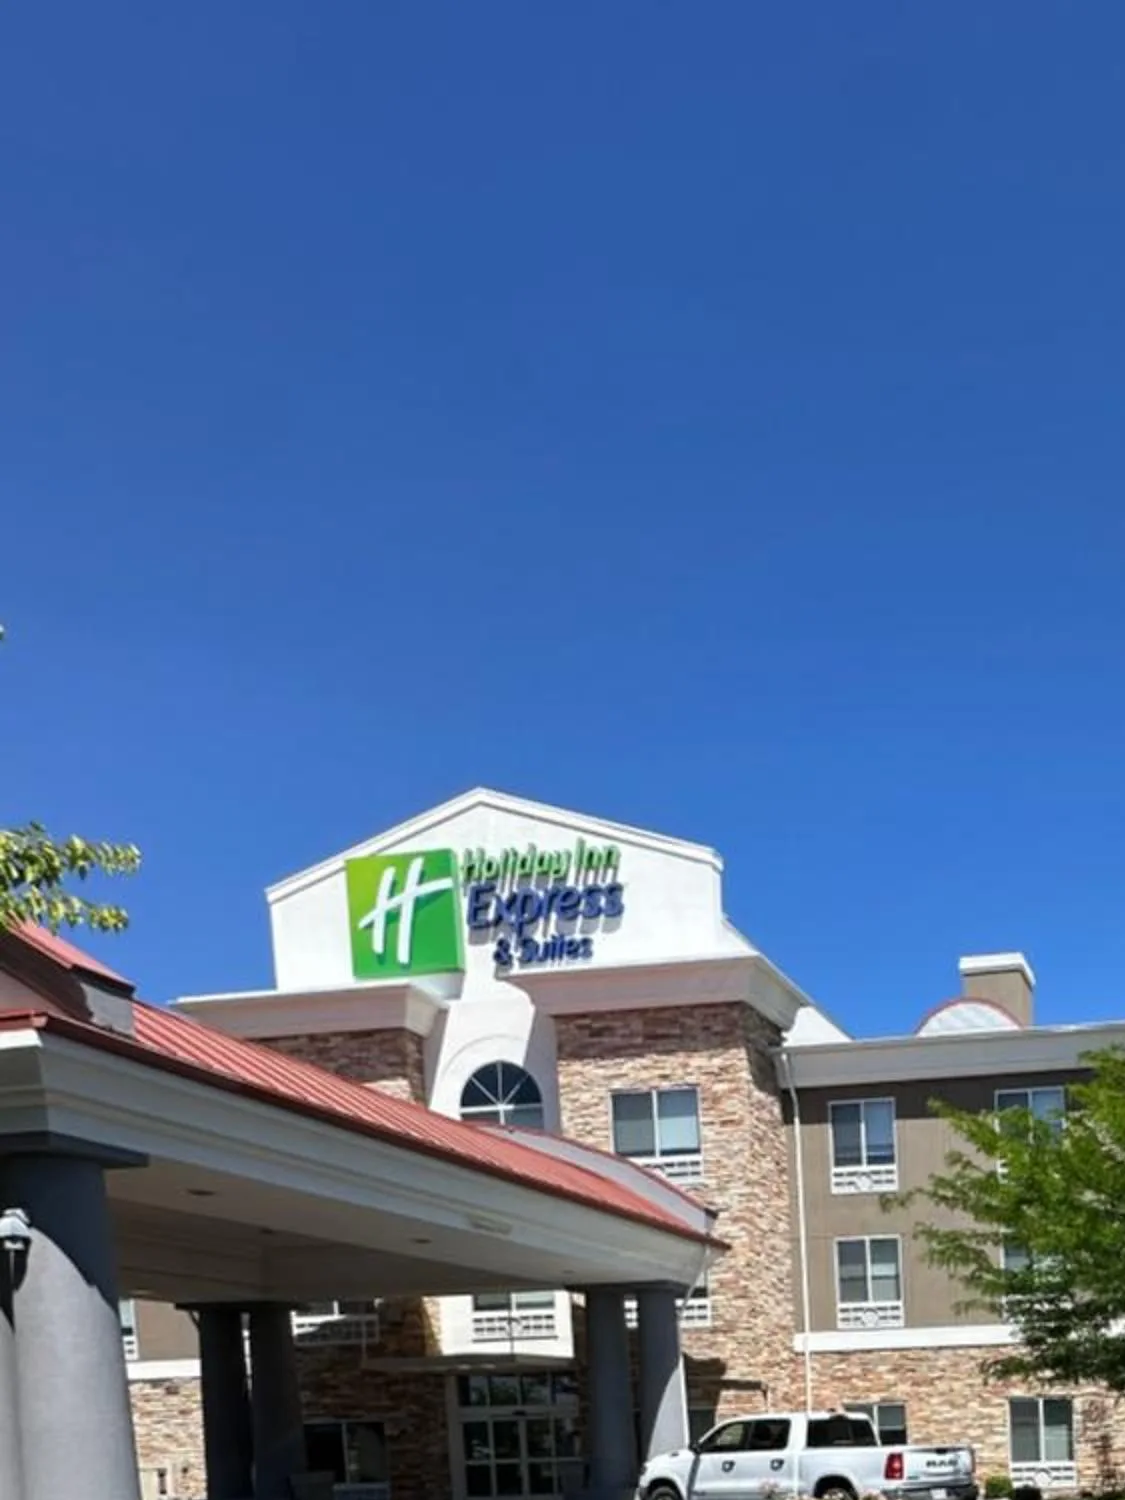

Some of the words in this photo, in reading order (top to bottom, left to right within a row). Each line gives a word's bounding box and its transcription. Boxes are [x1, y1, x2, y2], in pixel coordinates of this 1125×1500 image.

[463, 842, 572, 881] Holiday
[576, 837, 621, 869] Inn
[467, 881, 624, 938] Express
[493, 937, 513, 966] &
[517, 934, 594, 964] Suites
